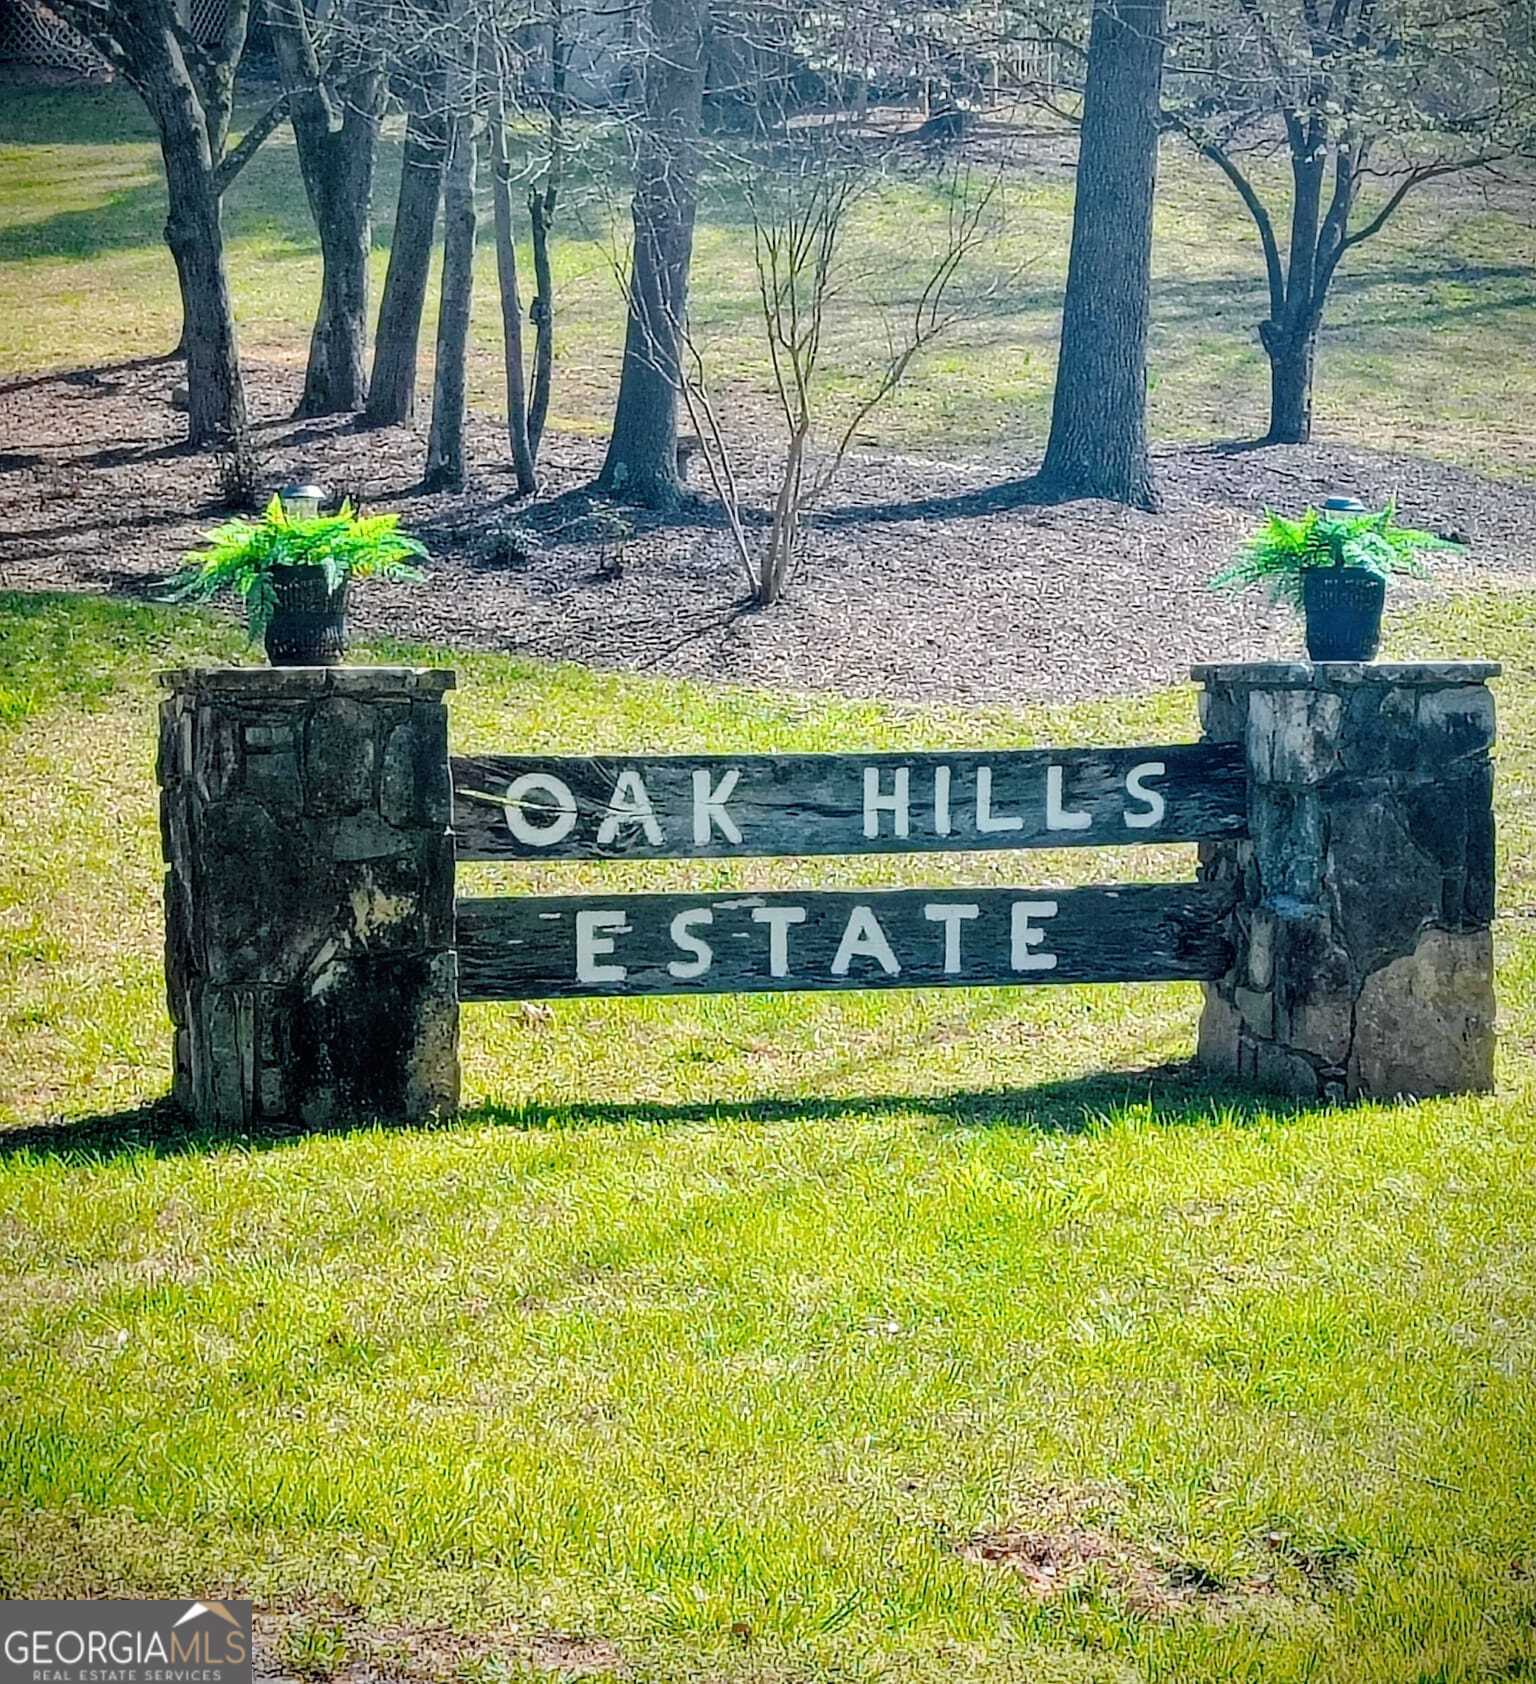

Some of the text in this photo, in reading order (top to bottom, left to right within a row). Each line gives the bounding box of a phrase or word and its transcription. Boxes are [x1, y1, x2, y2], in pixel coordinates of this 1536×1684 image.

[505, 762, 1166, 847] OAK HILLS
[576, 901, 1058, 983] ESTATE
